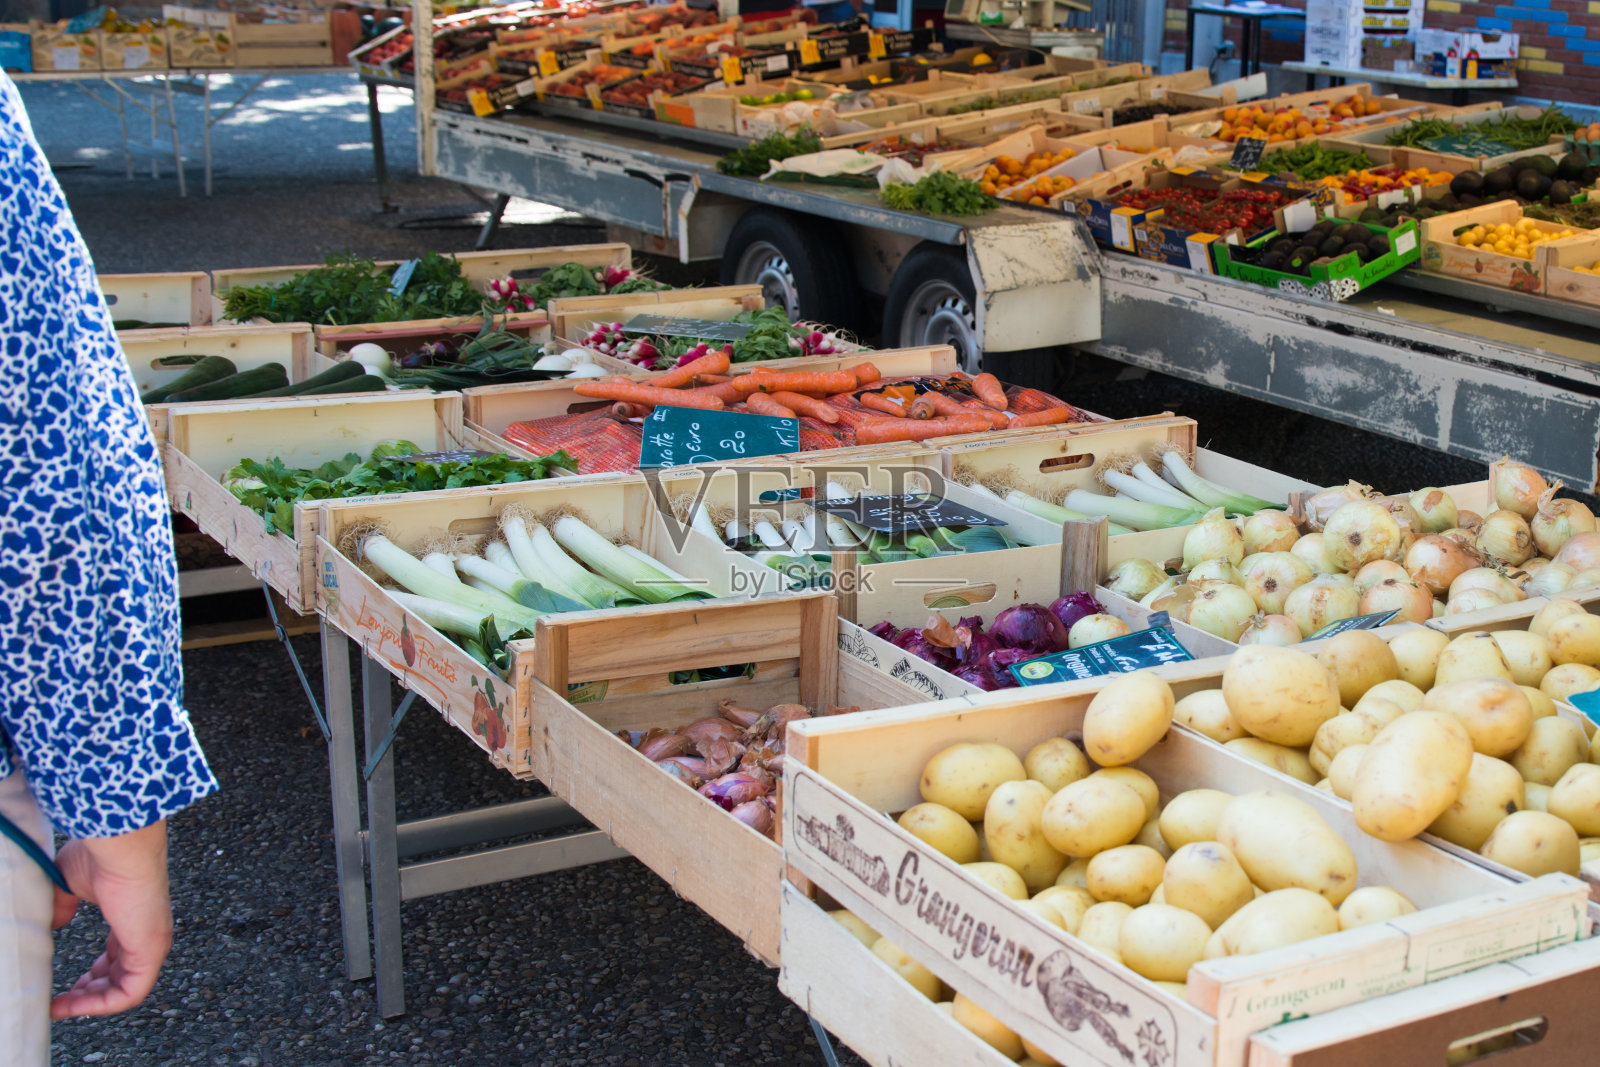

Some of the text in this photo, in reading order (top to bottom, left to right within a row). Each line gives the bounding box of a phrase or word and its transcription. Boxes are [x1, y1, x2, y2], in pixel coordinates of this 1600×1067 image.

[685, 422, 701, 452] Euro
[719, 430, 746, 454] 20
[771, 419, 793, 448] Kilo
[649, 432, 675, 469] arotte
[322, 573, 339, 589] LOCAL
[413, 633, 458, 683] Fruits
[1062, 653, 1093, 679] Origine
[893, 849, 1036, 988] Grangeron
[1246, 977, 1347, 1014] Grangeron
